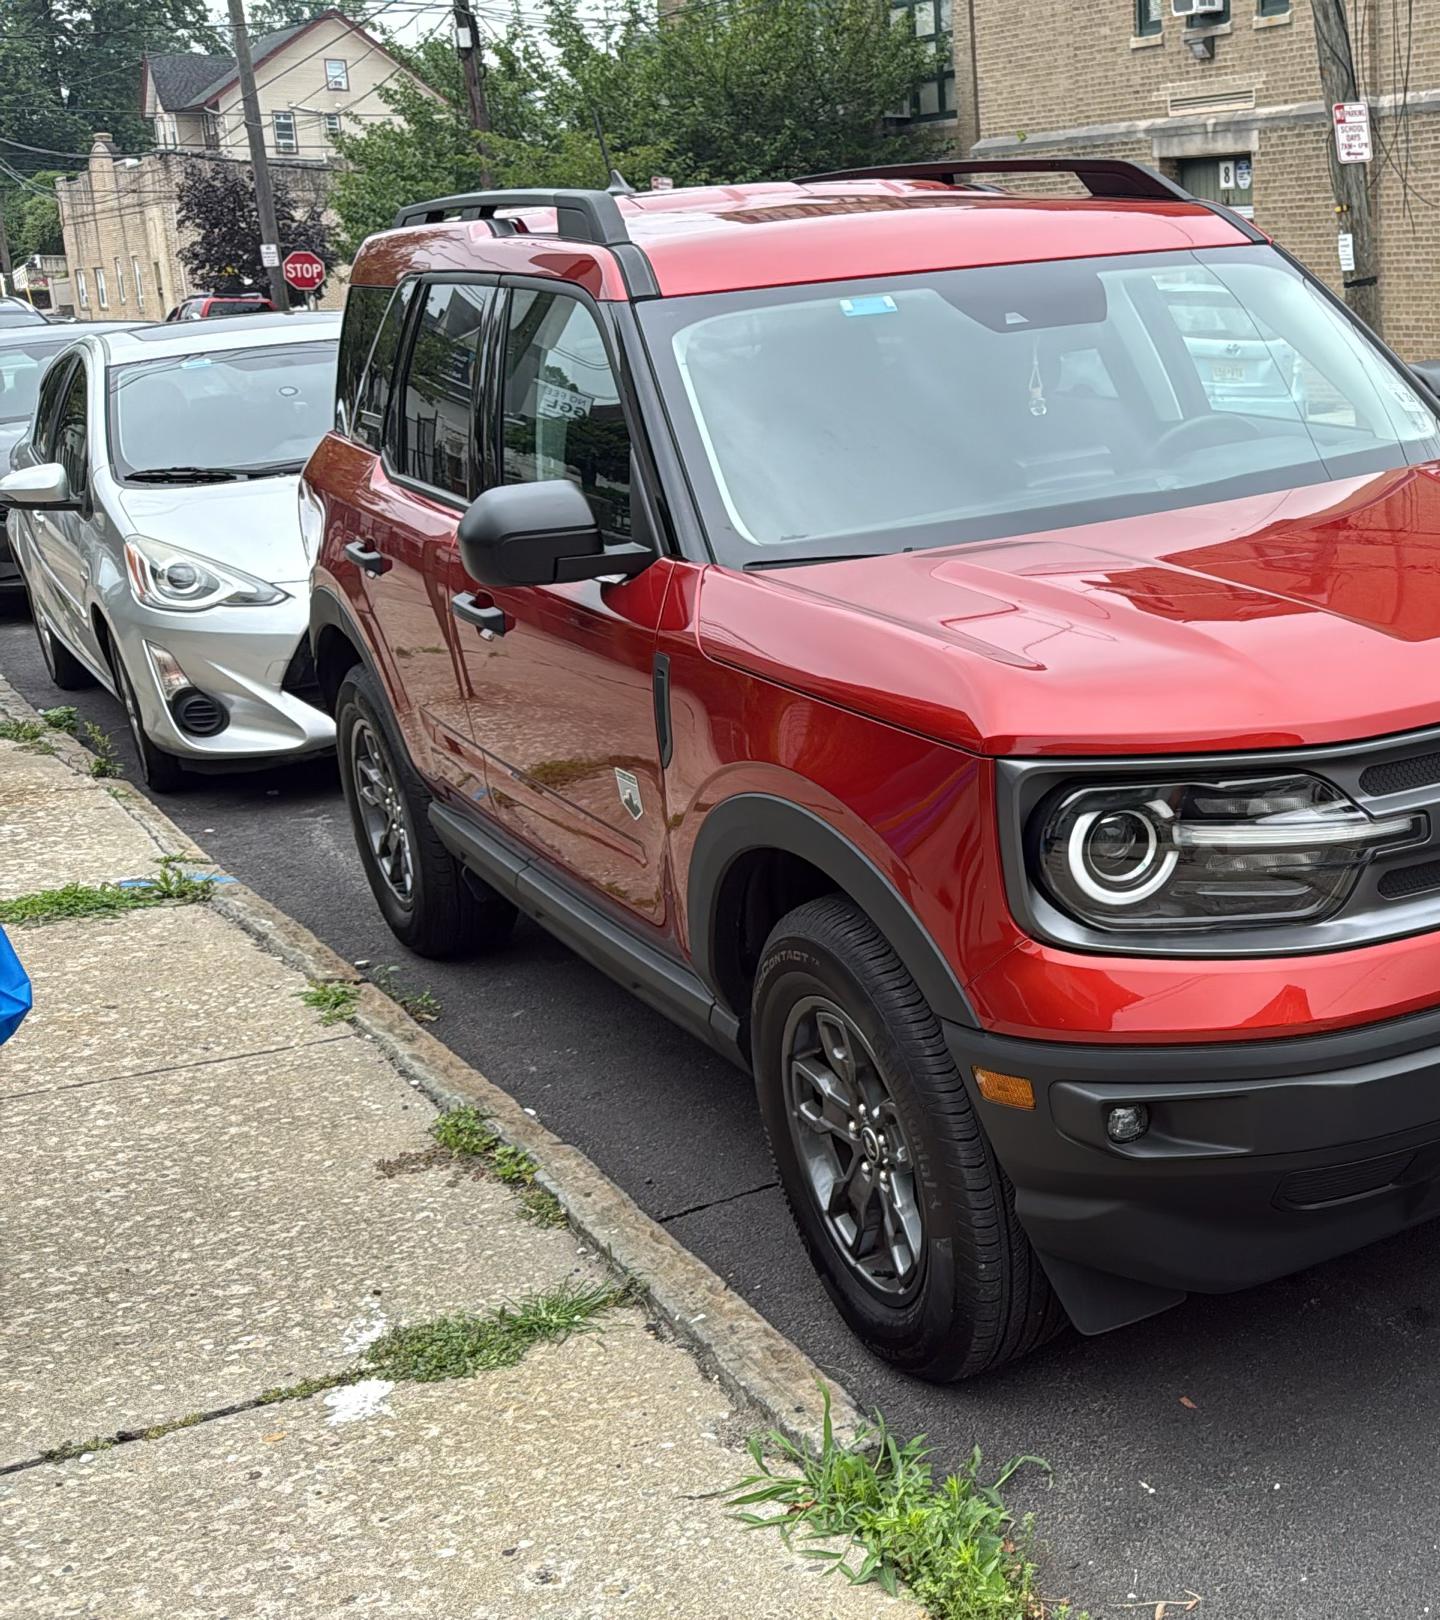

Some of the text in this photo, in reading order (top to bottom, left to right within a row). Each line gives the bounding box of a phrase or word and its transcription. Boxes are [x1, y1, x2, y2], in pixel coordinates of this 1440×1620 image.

[1340, 125, 1365, 133] SCHOOL
[1346, 134, 1361, 142] DAYS
[1224, 166, 1230, 184] 8
[286, 263, 321, 278] STOP
